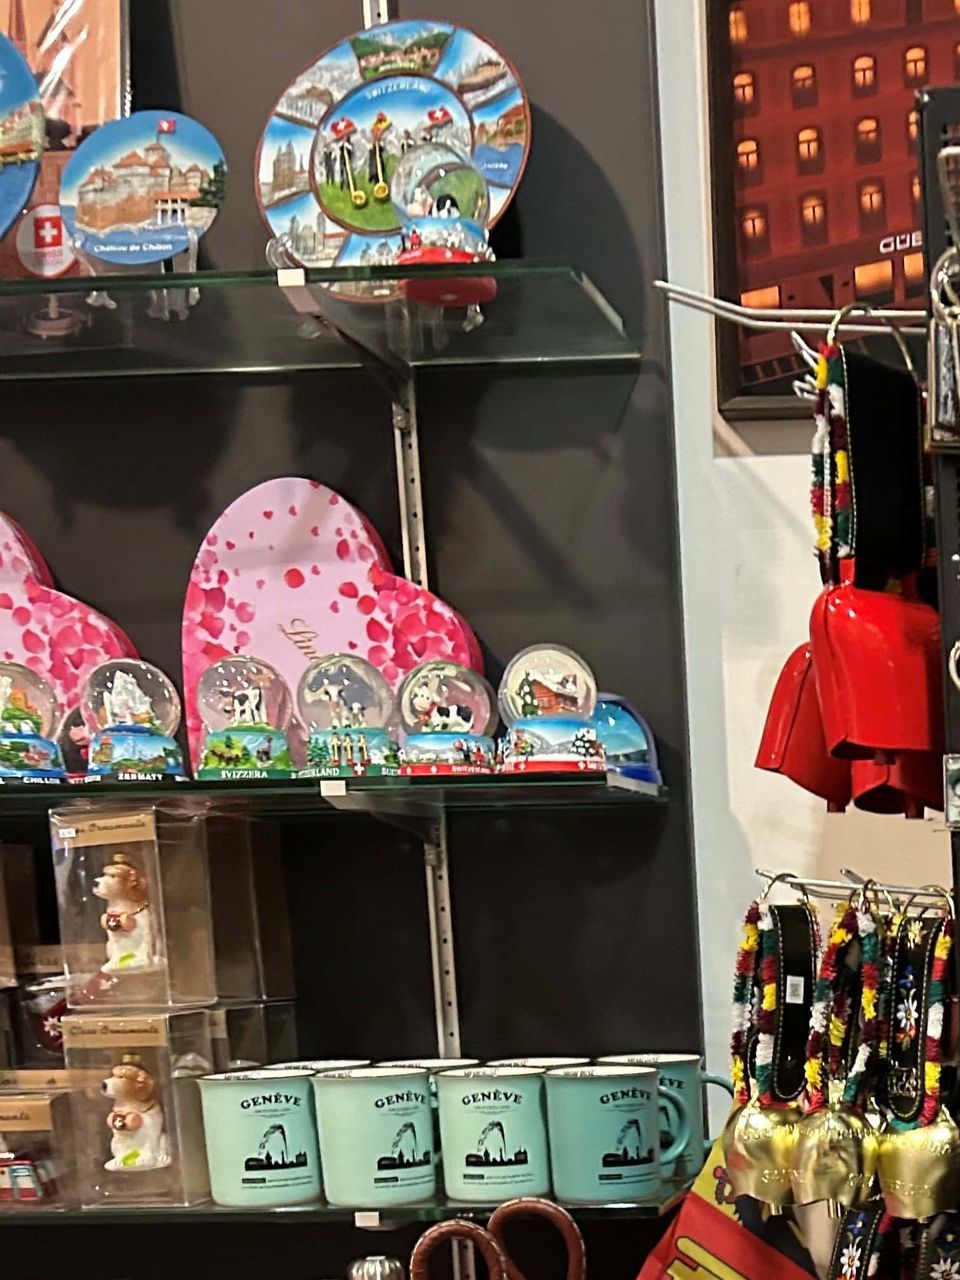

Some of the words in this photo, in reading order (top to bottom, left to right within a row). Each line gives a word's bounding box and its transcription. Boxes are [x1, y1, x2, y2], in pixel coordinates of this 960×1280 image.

[365, 80, 431, 100] SWITZERLAND
[129, 243, 141, 252] de
[220, 770, 268, 779] SVIZZERA
